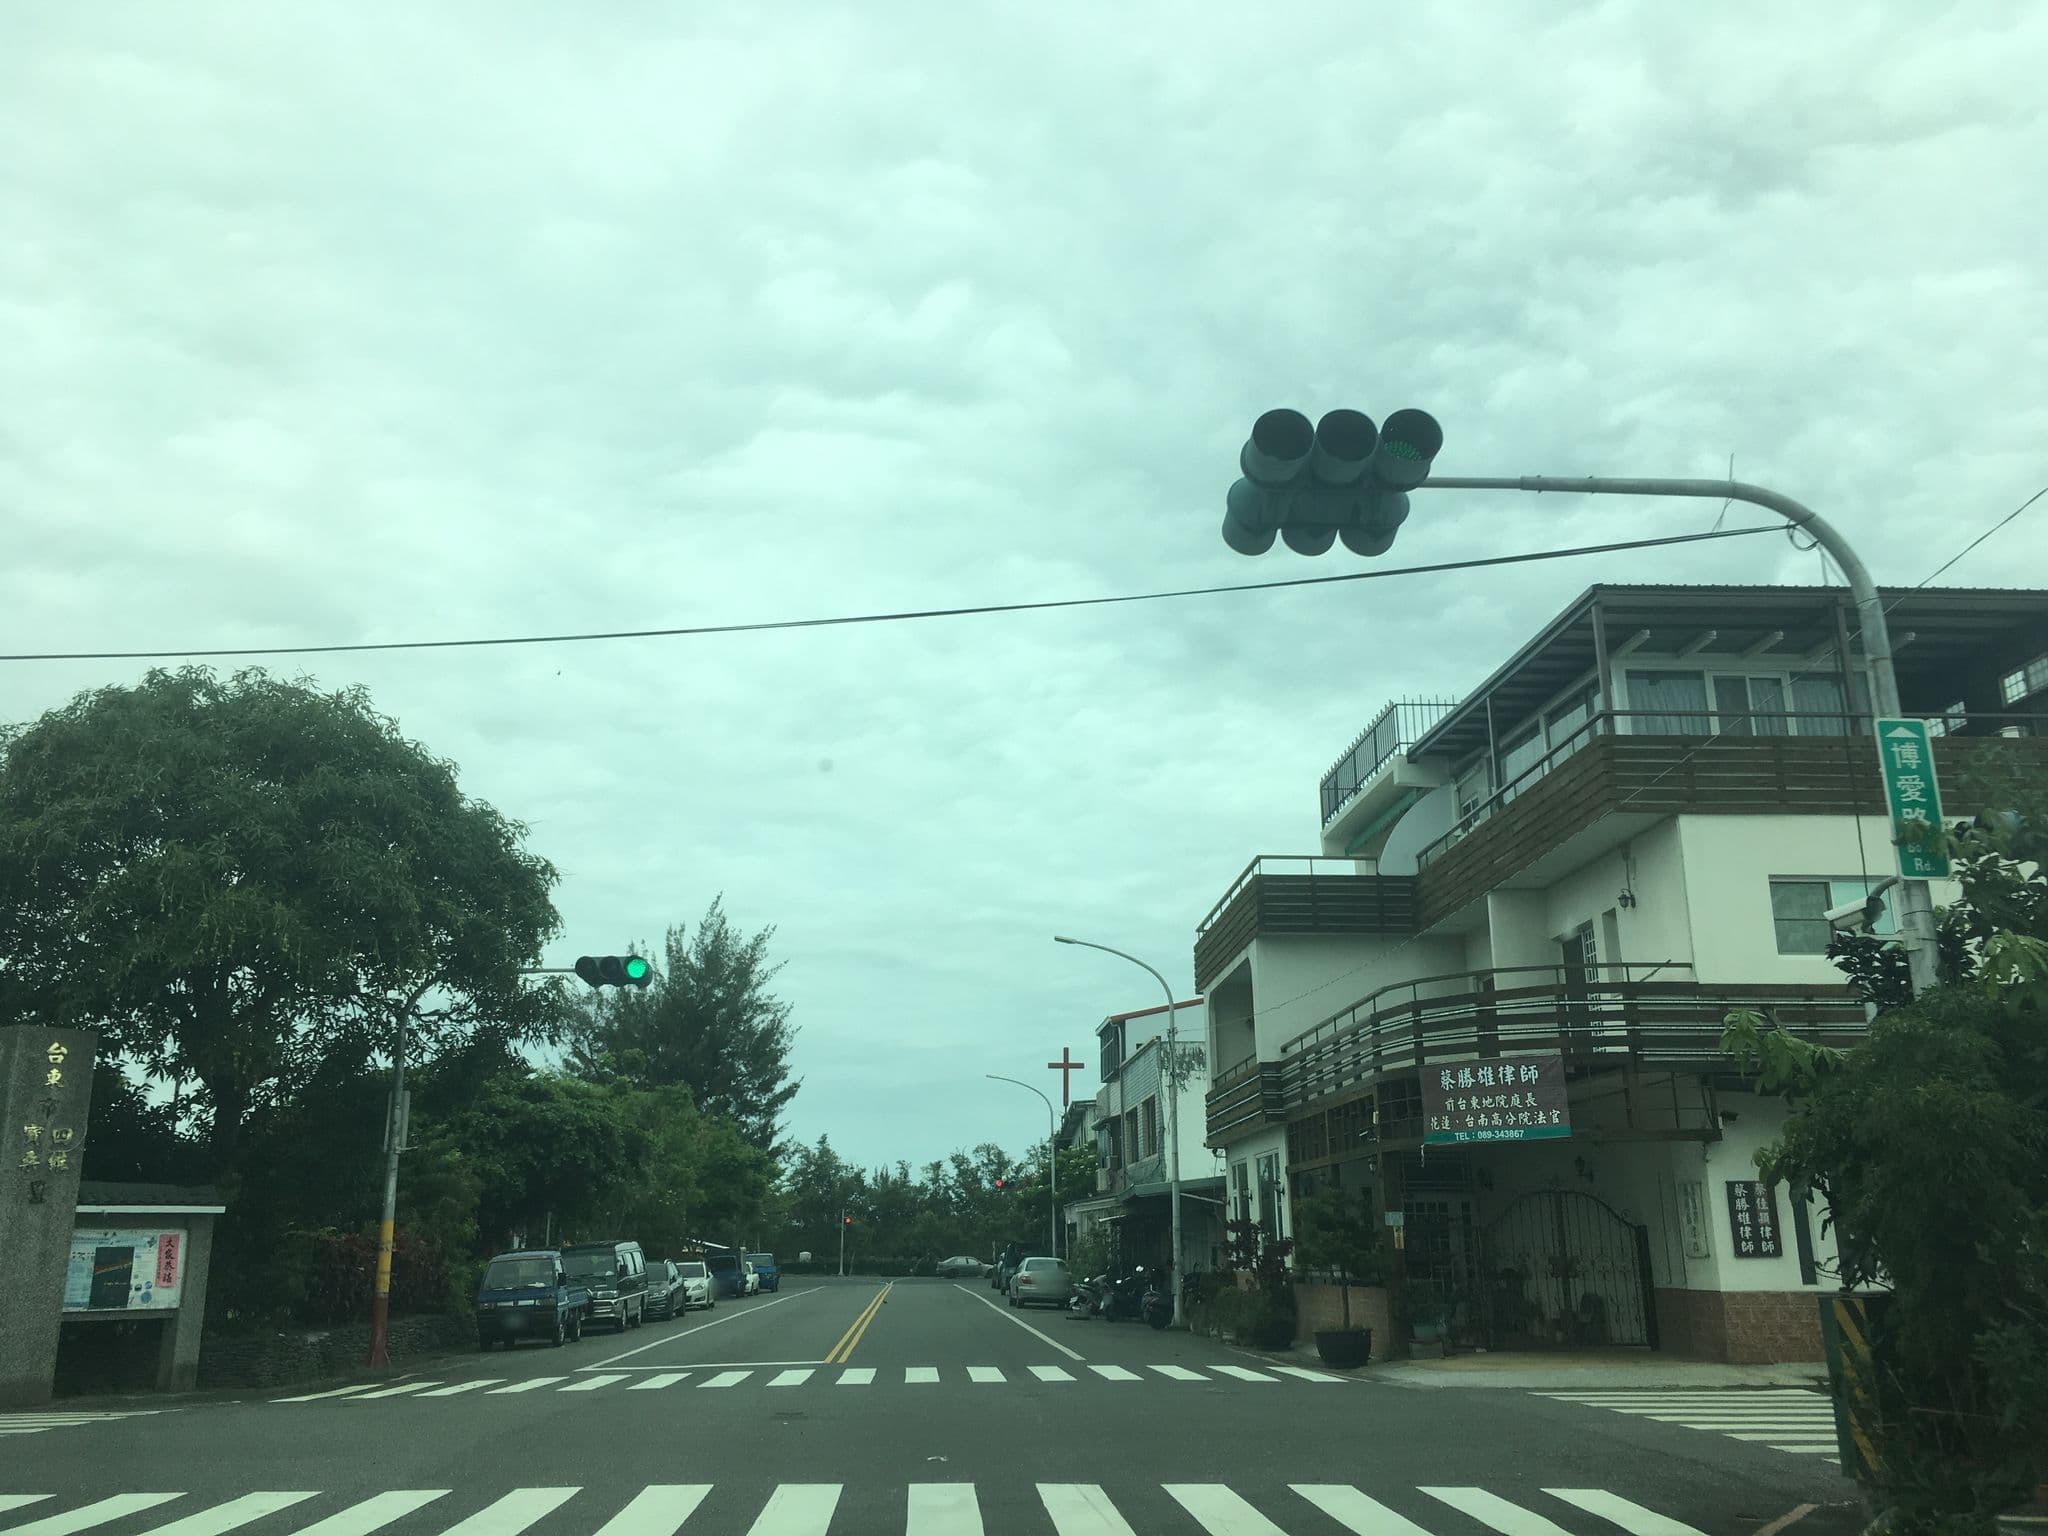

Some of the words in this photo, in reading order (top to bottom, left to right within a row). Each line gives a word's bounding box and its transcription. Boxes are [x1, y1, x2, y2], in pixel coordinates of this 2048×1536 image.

[1440, 1064, 1539, 1091] 蔡勝雄律師
[1445, 1092, 1538, 1112] 前台東地院庭長
[1734, 1183, 1754, 1254] 蔡勝雄律師
